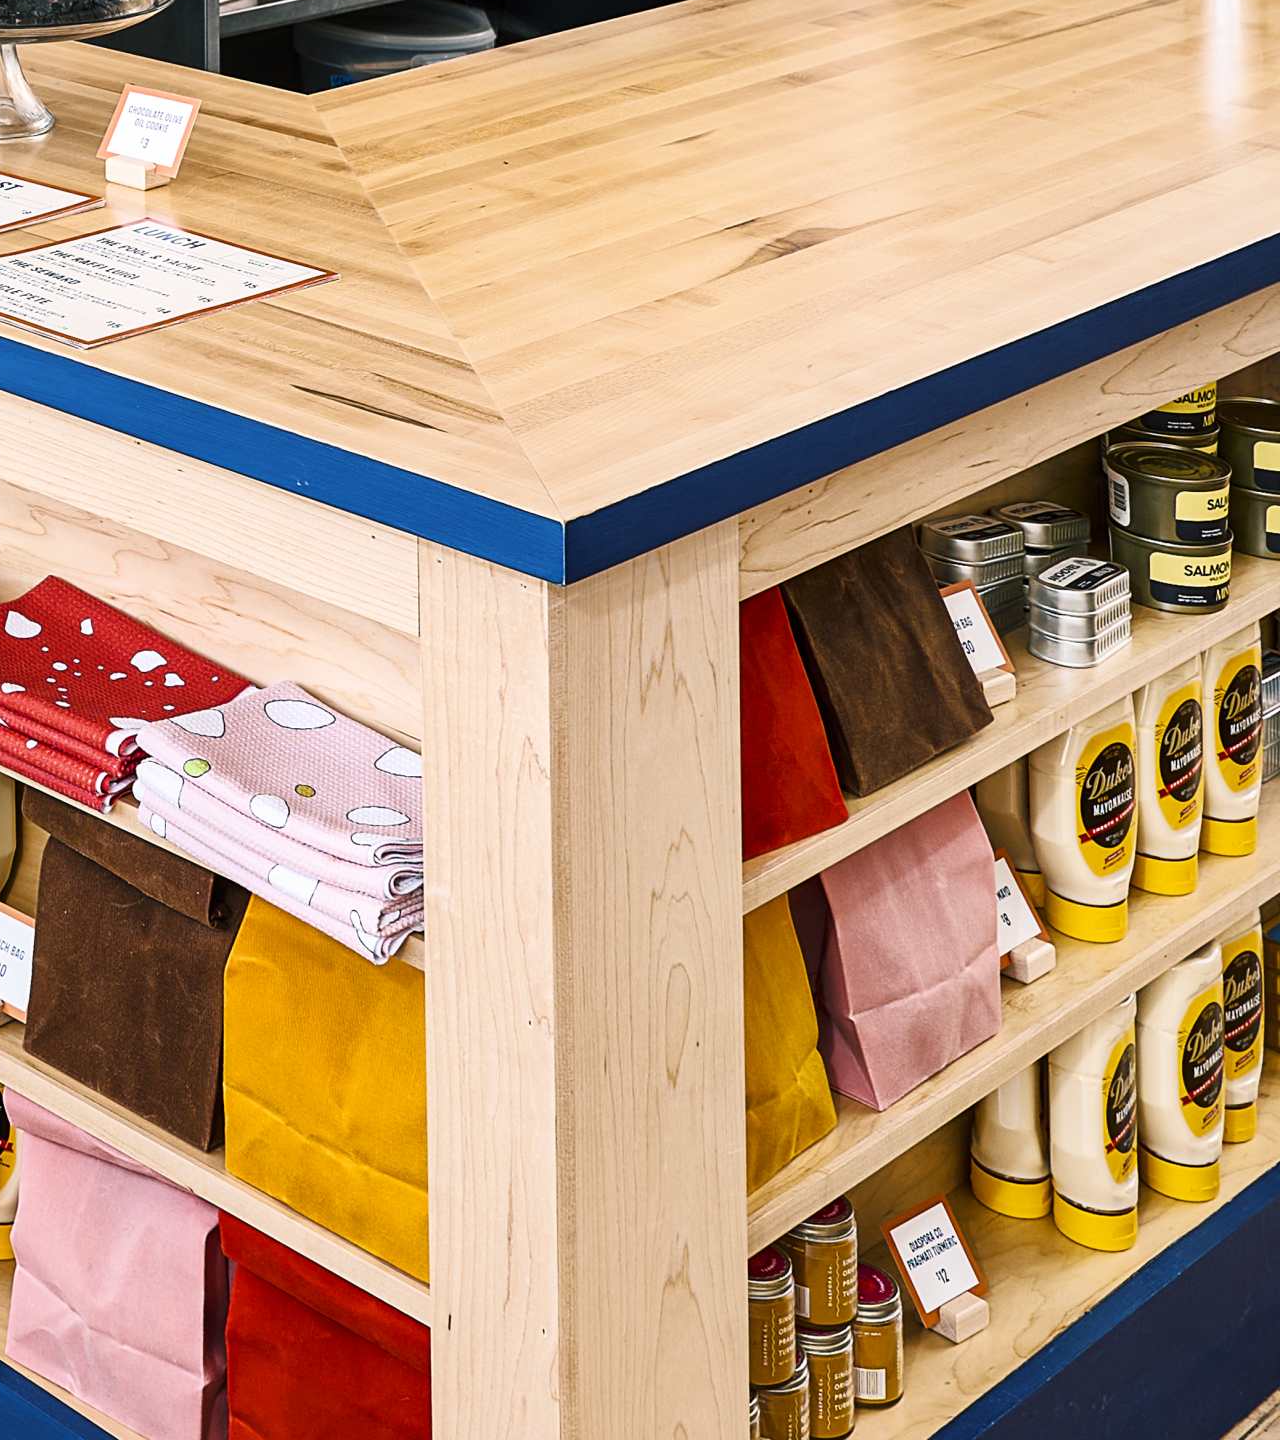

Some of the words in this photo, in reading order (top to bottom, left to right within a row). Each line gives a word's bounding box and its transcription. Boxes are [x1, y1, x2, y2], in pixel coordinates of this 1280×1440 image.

[132, 226, 207, 250] LUNCH
[9, 259, 30, 269] THE
[31, 265, 81, 286] SEWARD
[1094, 787, 1132, 816] MAYONNAISE
[10, 946, 25, 961] BAG
[1226, 993, 1261, 1021] MAYONNAISE
[906, 1246, 934, 1270] PRAGMATI
[933, 1235, 958, 1258] TURMERIC
[909, 1231, 935, 1253] DIASPORA
[936, 1268, 950, 1285] $12
